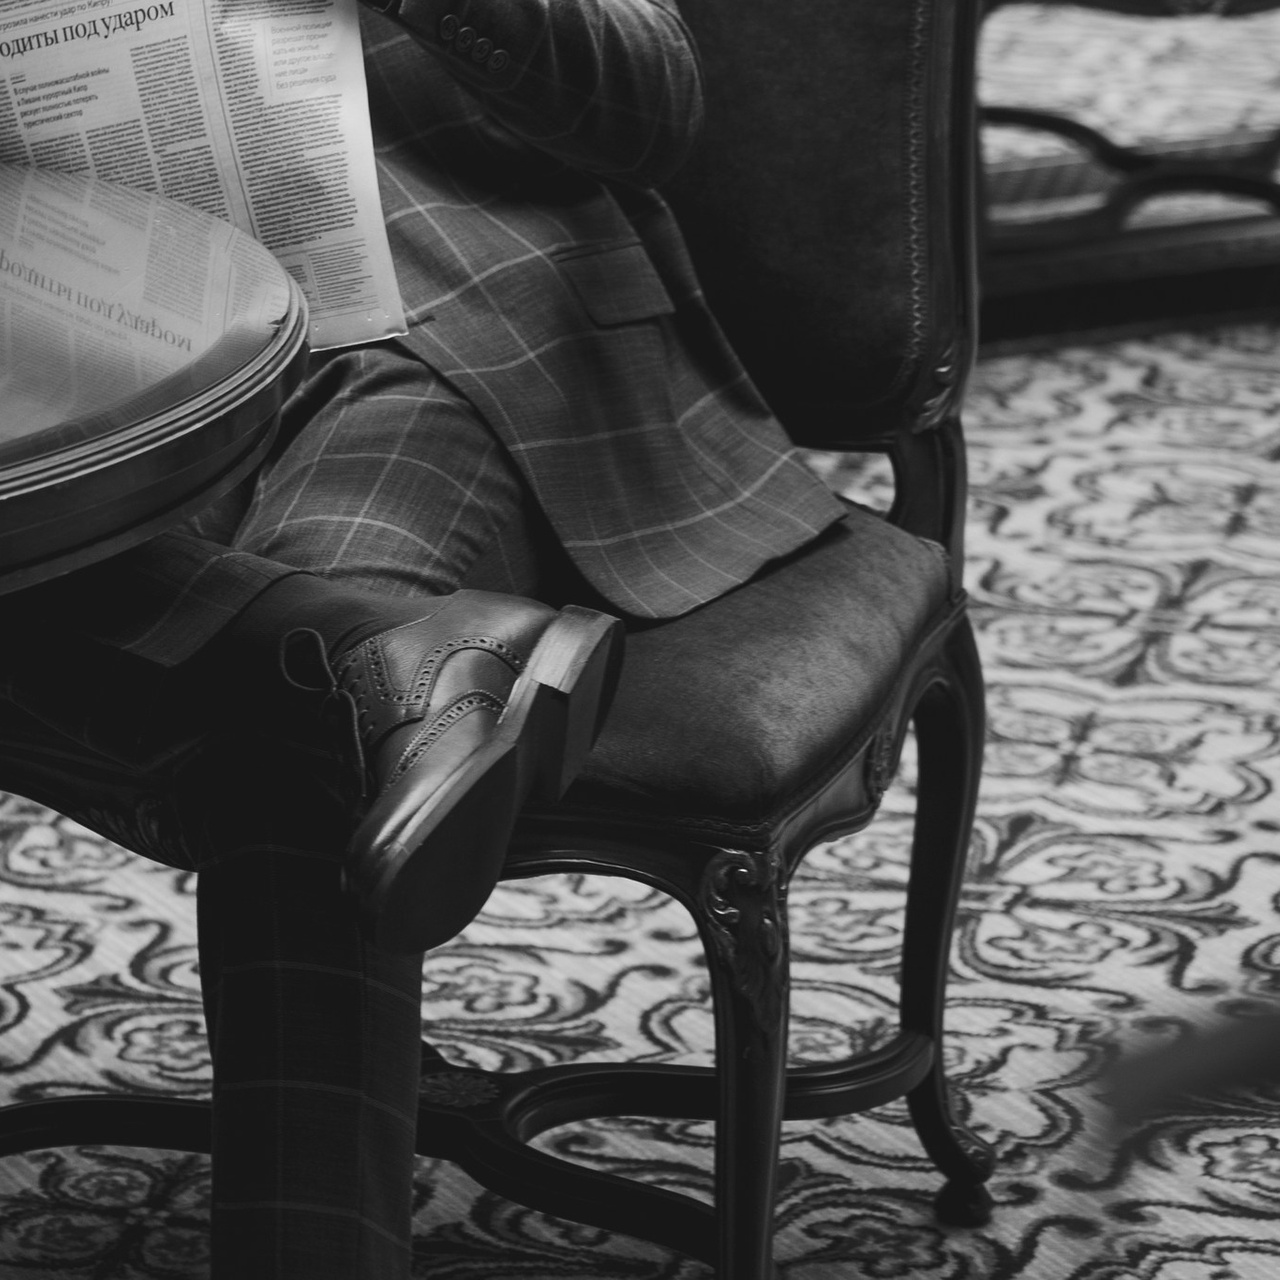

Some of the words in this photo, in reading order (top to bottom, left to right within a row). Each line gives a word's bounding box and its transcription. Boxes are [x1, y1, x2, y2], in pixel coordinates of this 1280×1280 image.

[29, 12, 58, 24] нанести
[59, 7, 76, 20] удар
[64, 18, 102, 42] под
[102, 1, 175, 40] ударом
